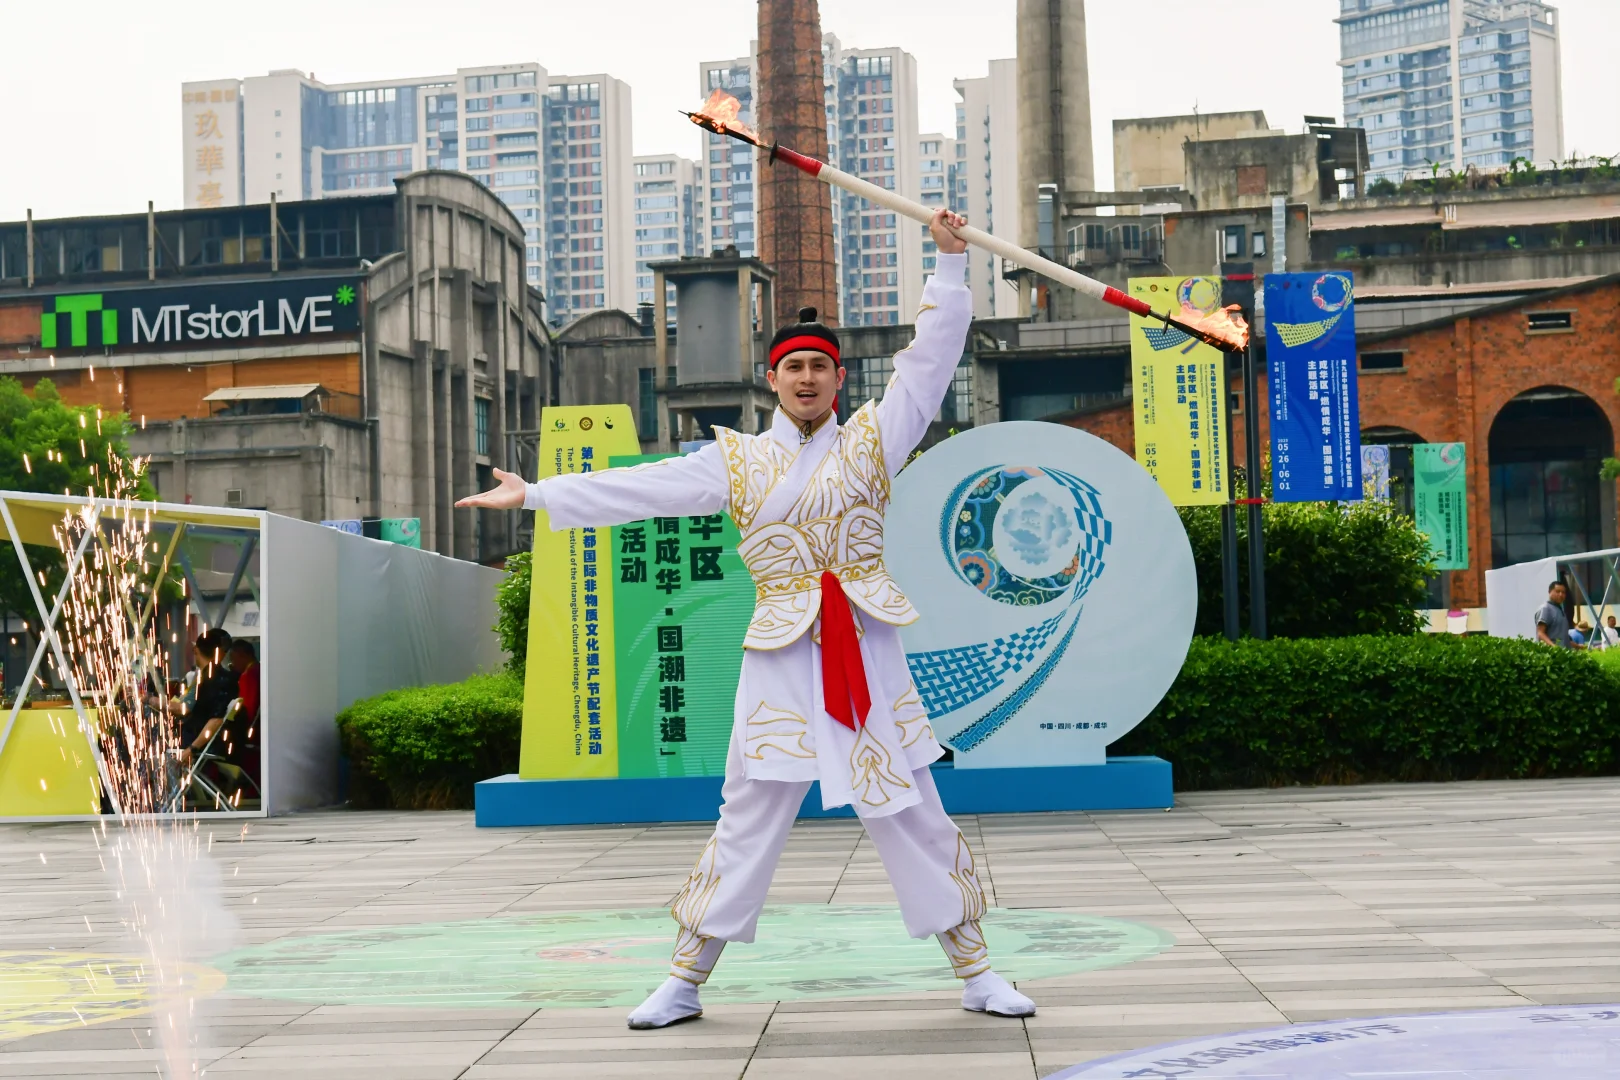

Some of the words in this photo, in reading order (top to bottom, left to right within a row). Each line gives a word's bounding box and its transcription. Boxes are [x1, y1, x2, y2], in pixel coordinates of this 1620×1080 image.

[1145, 447, 1156, 455] 05
[1277, 443, 1289, 451] 05
[555, 447, 563, 475] Suppor
[1146, 459, 1157, 467] 26
[1278, 455, 1289, 463] 26
[1278, 470, 1290, 478] 06
[1279, 482, 1291, 490] 01
[619, 520, 648, 584] 活动
[571, 557, 577, 566] of
[570, 567, 578, 581] the
[569, 582, 579, 622] Intangible
[571, 624, 580, 656] Cultural
[571, 657, 582, 693] Heritage,
[572, 694, 581, 732] Chengdu,
[574, 733, 582, 756] China
